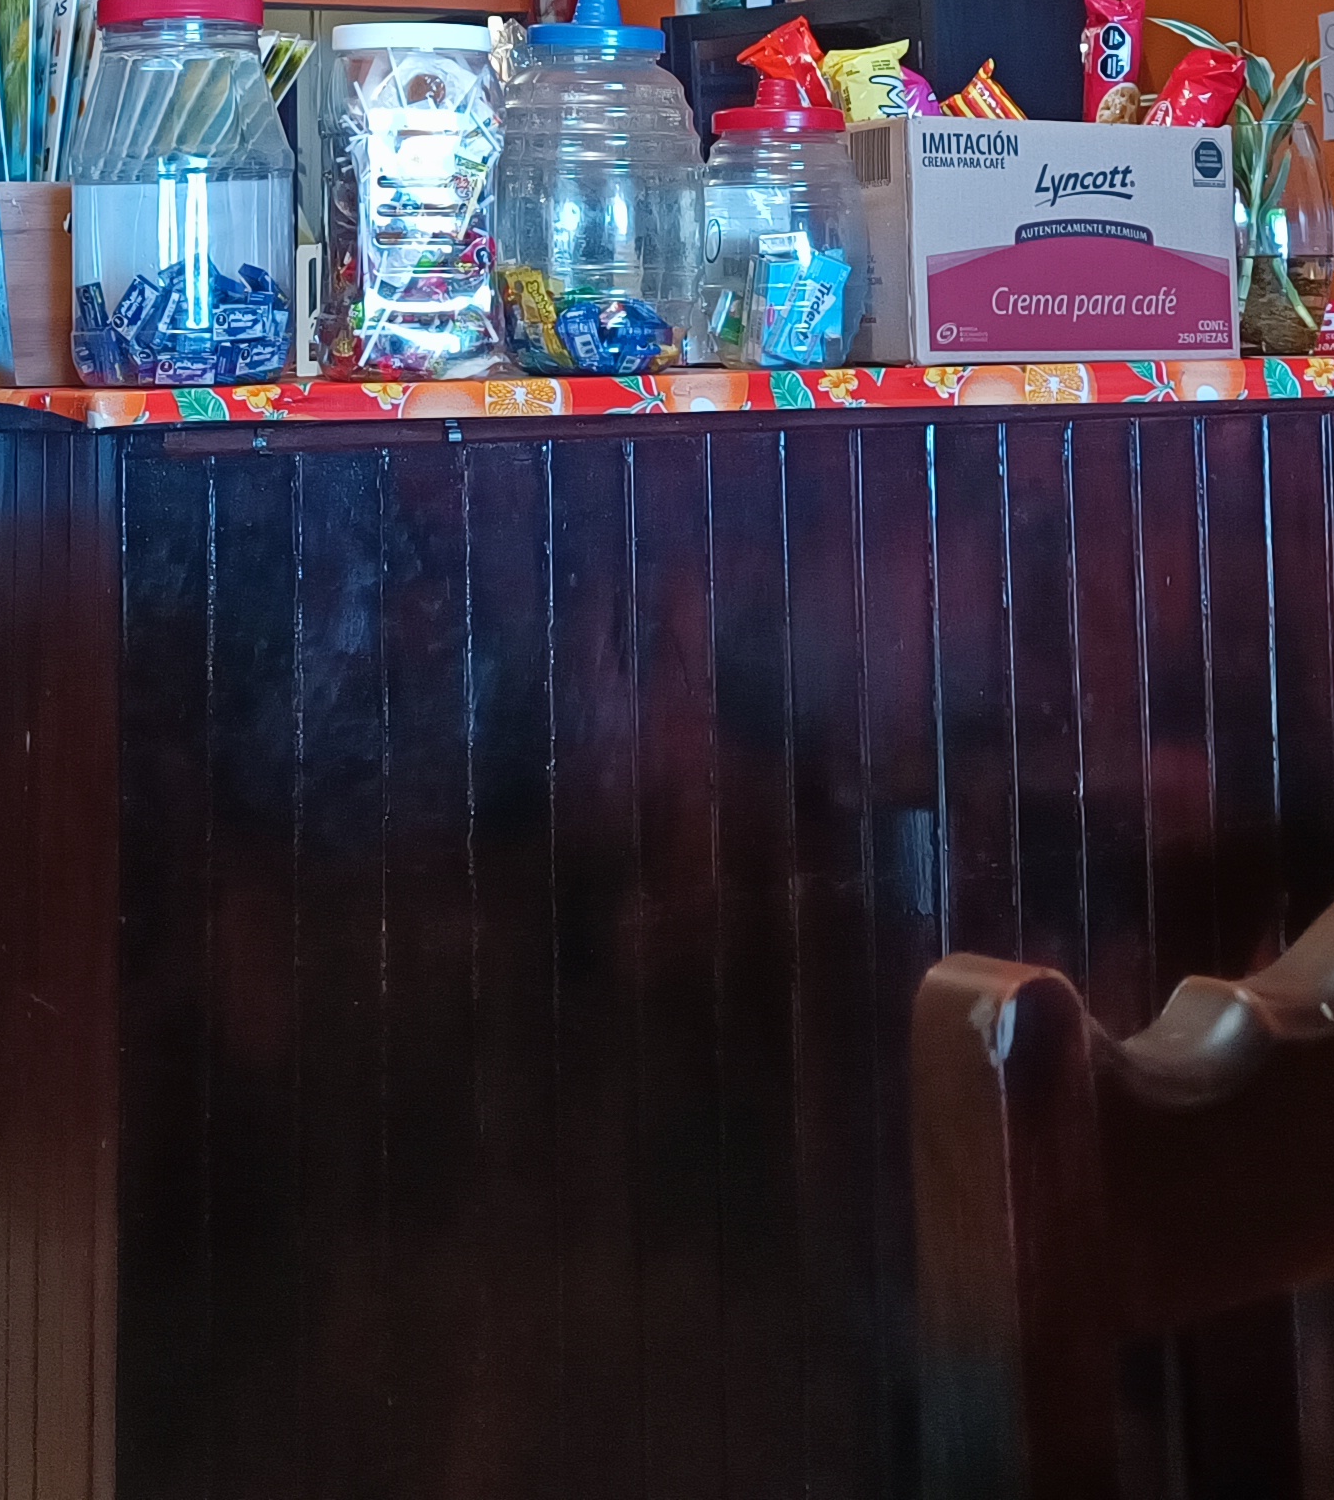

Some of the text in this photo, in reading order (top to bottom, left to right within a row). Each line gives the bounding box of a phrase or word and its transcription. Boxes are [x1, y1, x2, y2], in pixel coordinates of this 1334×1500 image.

[922, 130, 1019, 157] IMITACIÓN
[922, 156, 1006, 170] CREMA PARA CAFÉ
[1034, 163, 1134, 208] Lyncott
[1020, 223, 1148, 241] AUTENTICAMENTE PREMIUM
[798, 281, 833, 341] Trident
[991, 286, 1177, 323] Crema para café
[1178, 333, 1229, 344] 250 PIEZAS
